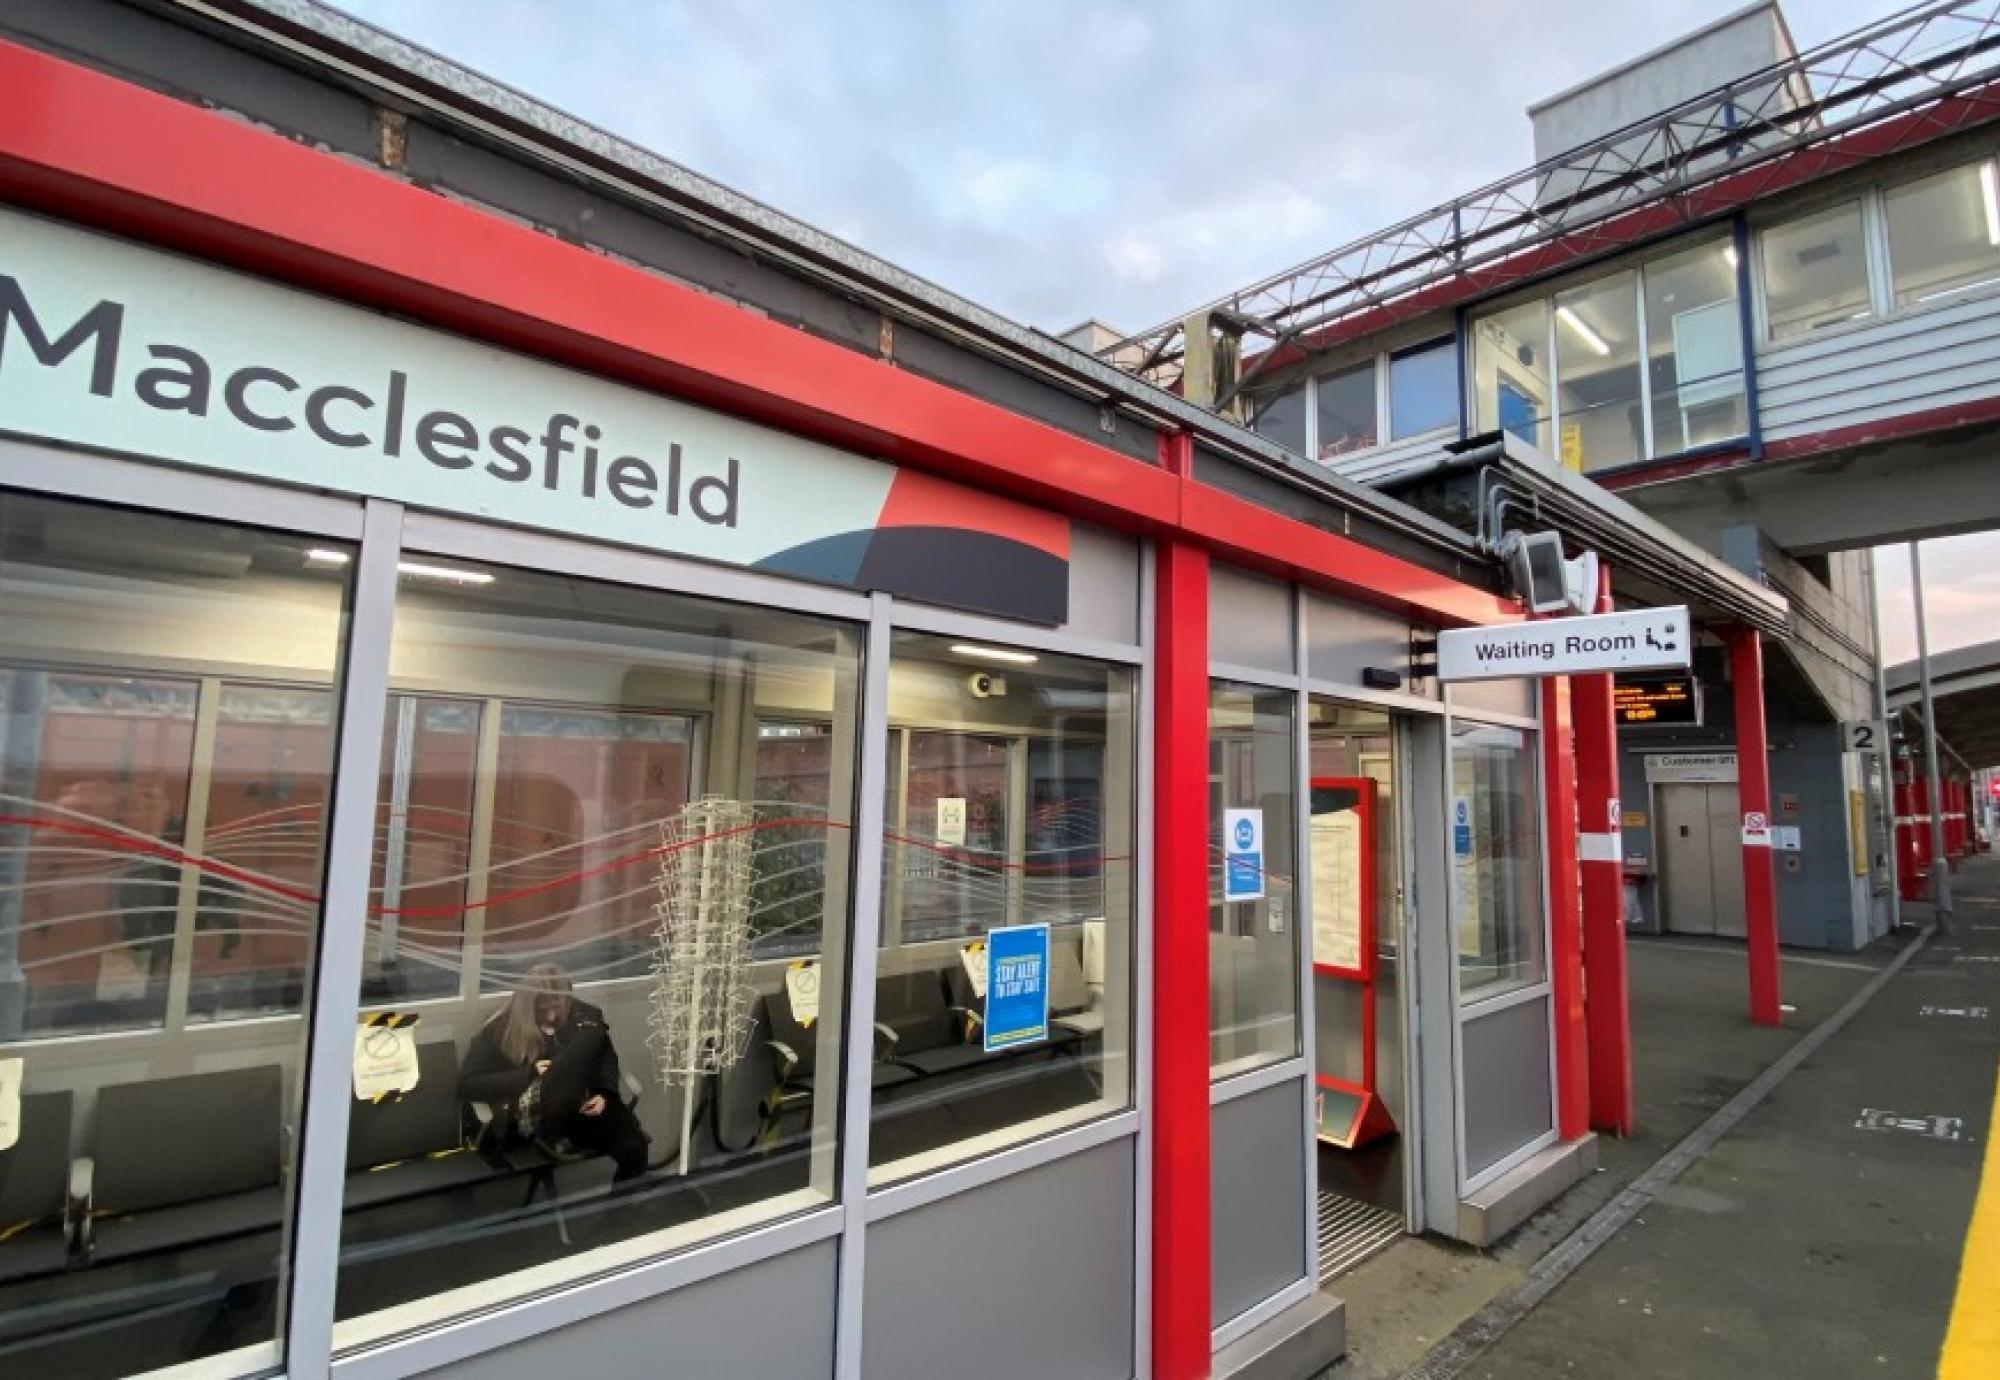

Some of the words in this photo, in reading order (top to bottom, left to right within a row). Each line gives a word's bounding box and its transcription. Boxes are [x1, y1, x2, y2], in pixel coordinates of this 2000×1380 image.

[0, 274, 741, 528] Macclesfield
[1475, 639, 1555, 661] Waiting
[1565, 635, 1636, 654] Room
[1853, 726, 1873, 748] 2
